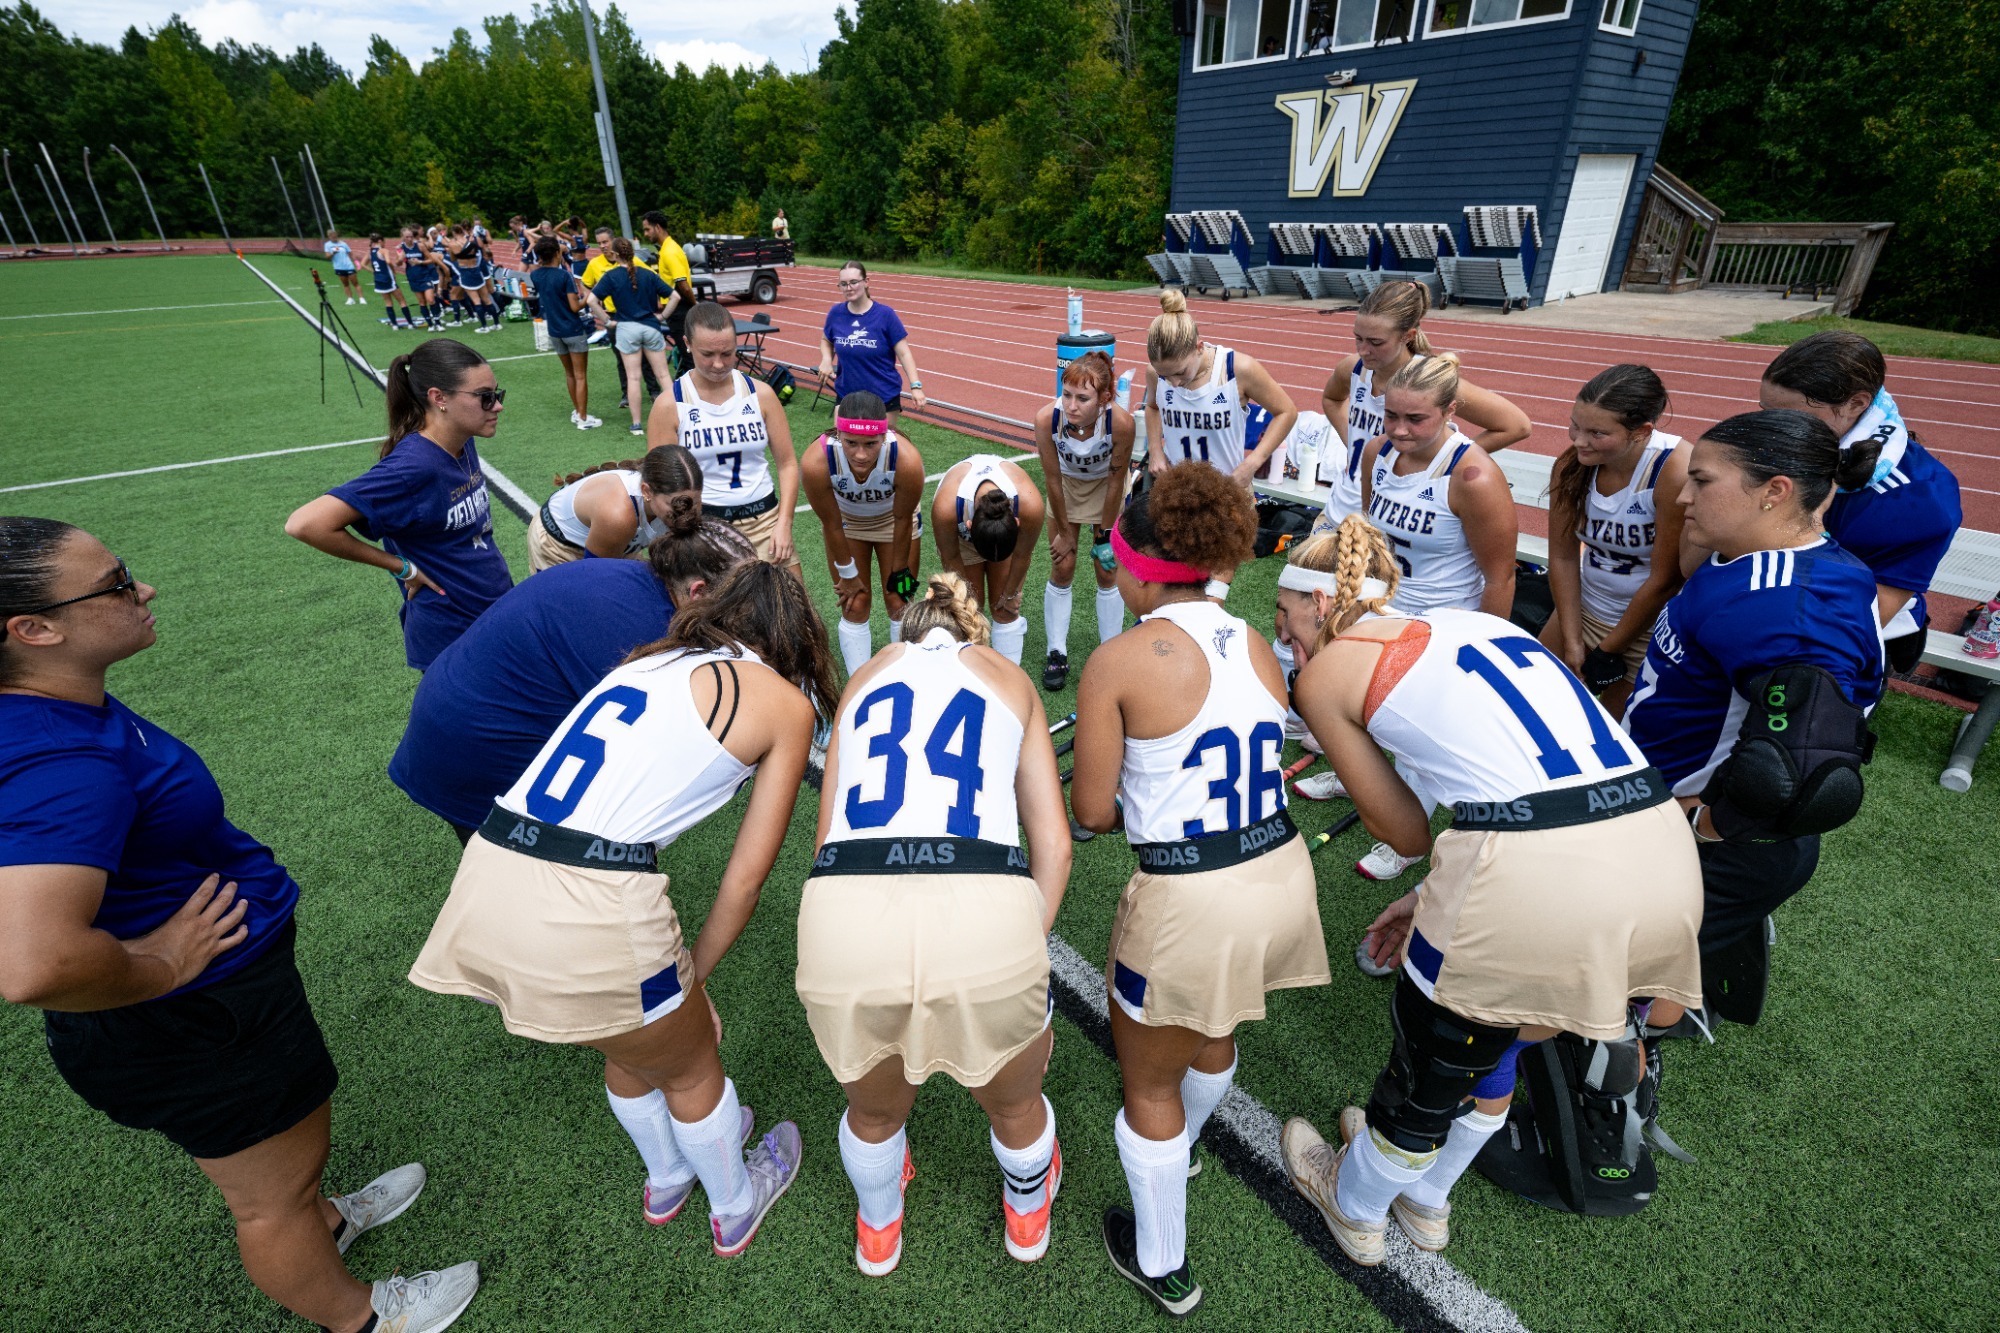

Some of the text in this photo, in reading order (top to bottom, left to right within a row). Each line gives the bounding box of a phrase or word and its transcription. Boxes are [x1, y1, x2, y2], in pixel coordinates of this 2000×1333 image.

[1274, 78, 1419, 198] W
[684, 421, 765, 449] CONVERSE
[1162, 407, 1231, 430] CONVERSE
[1348, 404, 1386, 437] CONVE
[1180, 435, 1209, 462] 11
[716, 450, 743, 489] 7
[1455, 635, 1635, 782] 17
[525, 684, 649, 827] 6
[843, 680, 988, 840] 34
[1598, 1167, 1630, 1178] OBO
